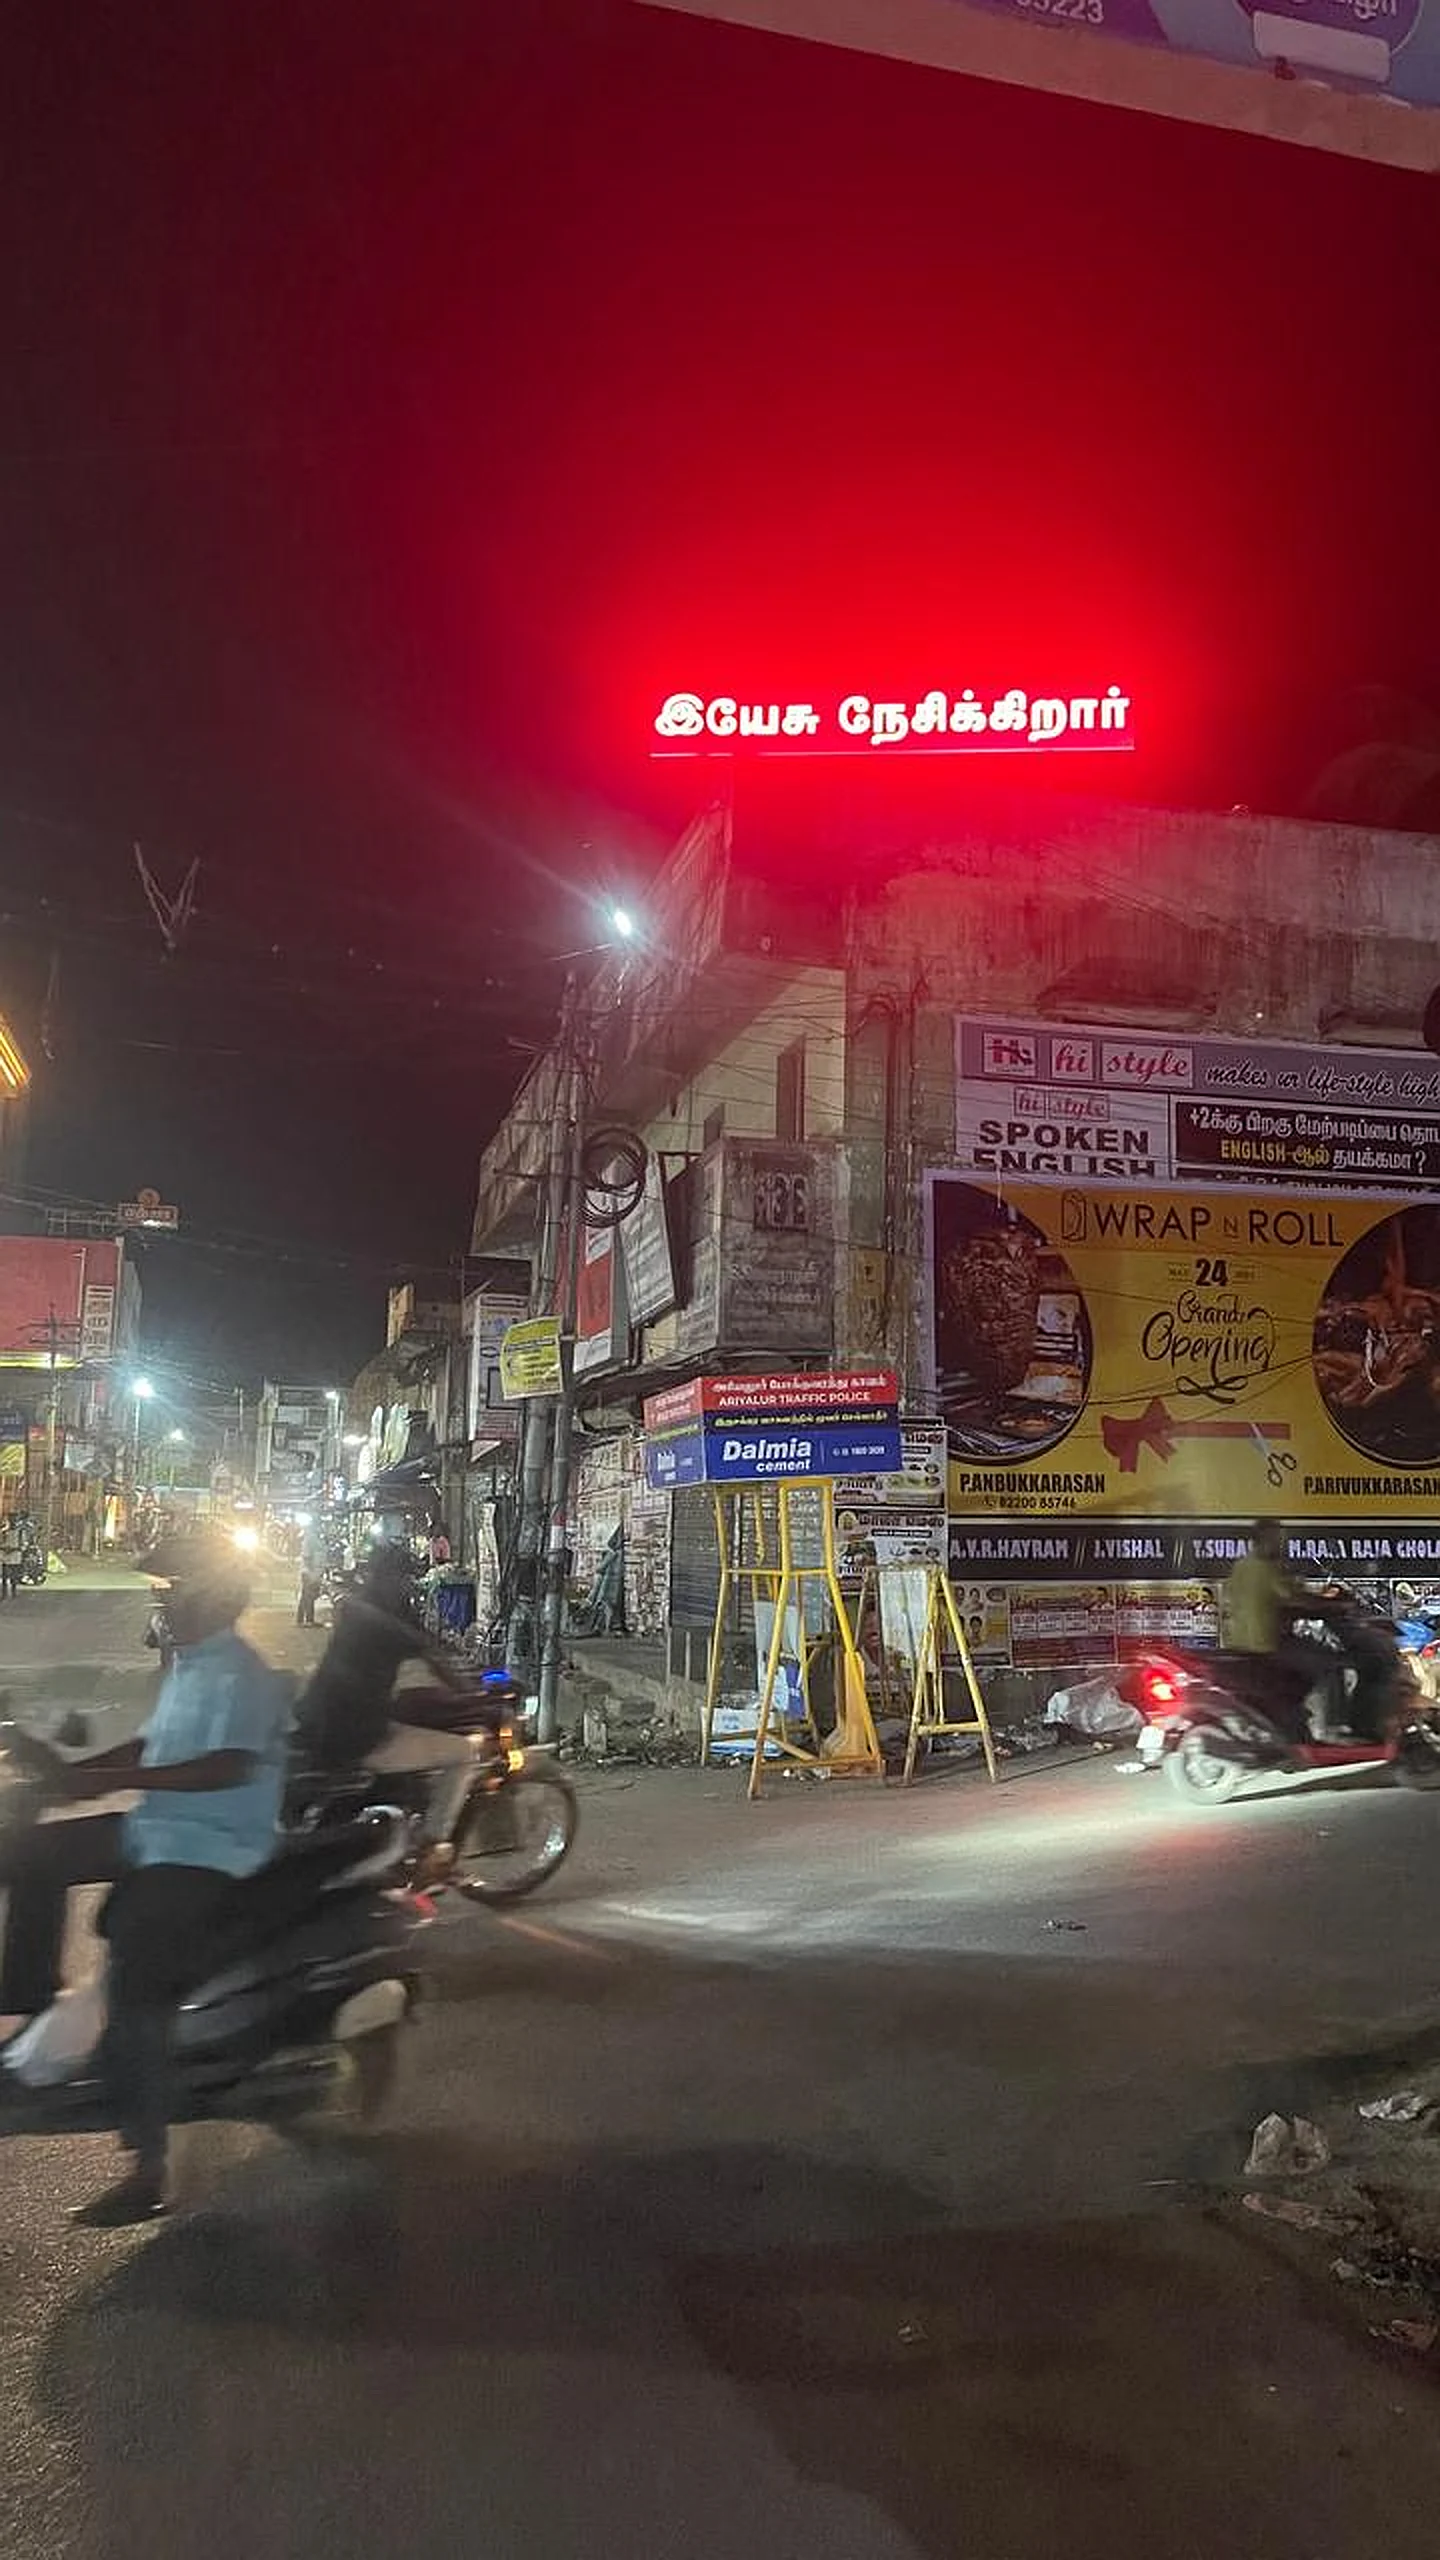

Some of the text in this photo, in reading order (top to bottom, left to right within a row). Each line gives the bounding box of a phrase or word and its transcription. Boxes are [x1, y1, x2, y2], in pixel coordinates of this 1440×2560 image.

[654, 685, 1131, 745] இயேசு நேசிக்கிறார்
[1054, 1044, 1088, 1073] hi
[1106, 1049, 1188, 1084] style
[1205, 1059, 1268, 1086] makes
[1018, 1090, 1107, 1120] hi style
[978, 1119, 1150, 1155] SPOKEN
[1094, 1203, 1344, 1247] WRAP N ROLL
[1195, 1258, 1229, 1287] 24
[1177, 1290, 1246, 1323] Grand
[1142, 1308, 1275, 1371] Opening
[719, 1391, 871, 1406] ARIYALUR TRAFFIC POLICE
[723, 1437, 812, 1462] Dalmia
[756, 1461, 811, 1473] cement
[1193, 1538, 1254, 1559] Y.SUBA
[1351, 1538, 1393, 1559] RAJA
